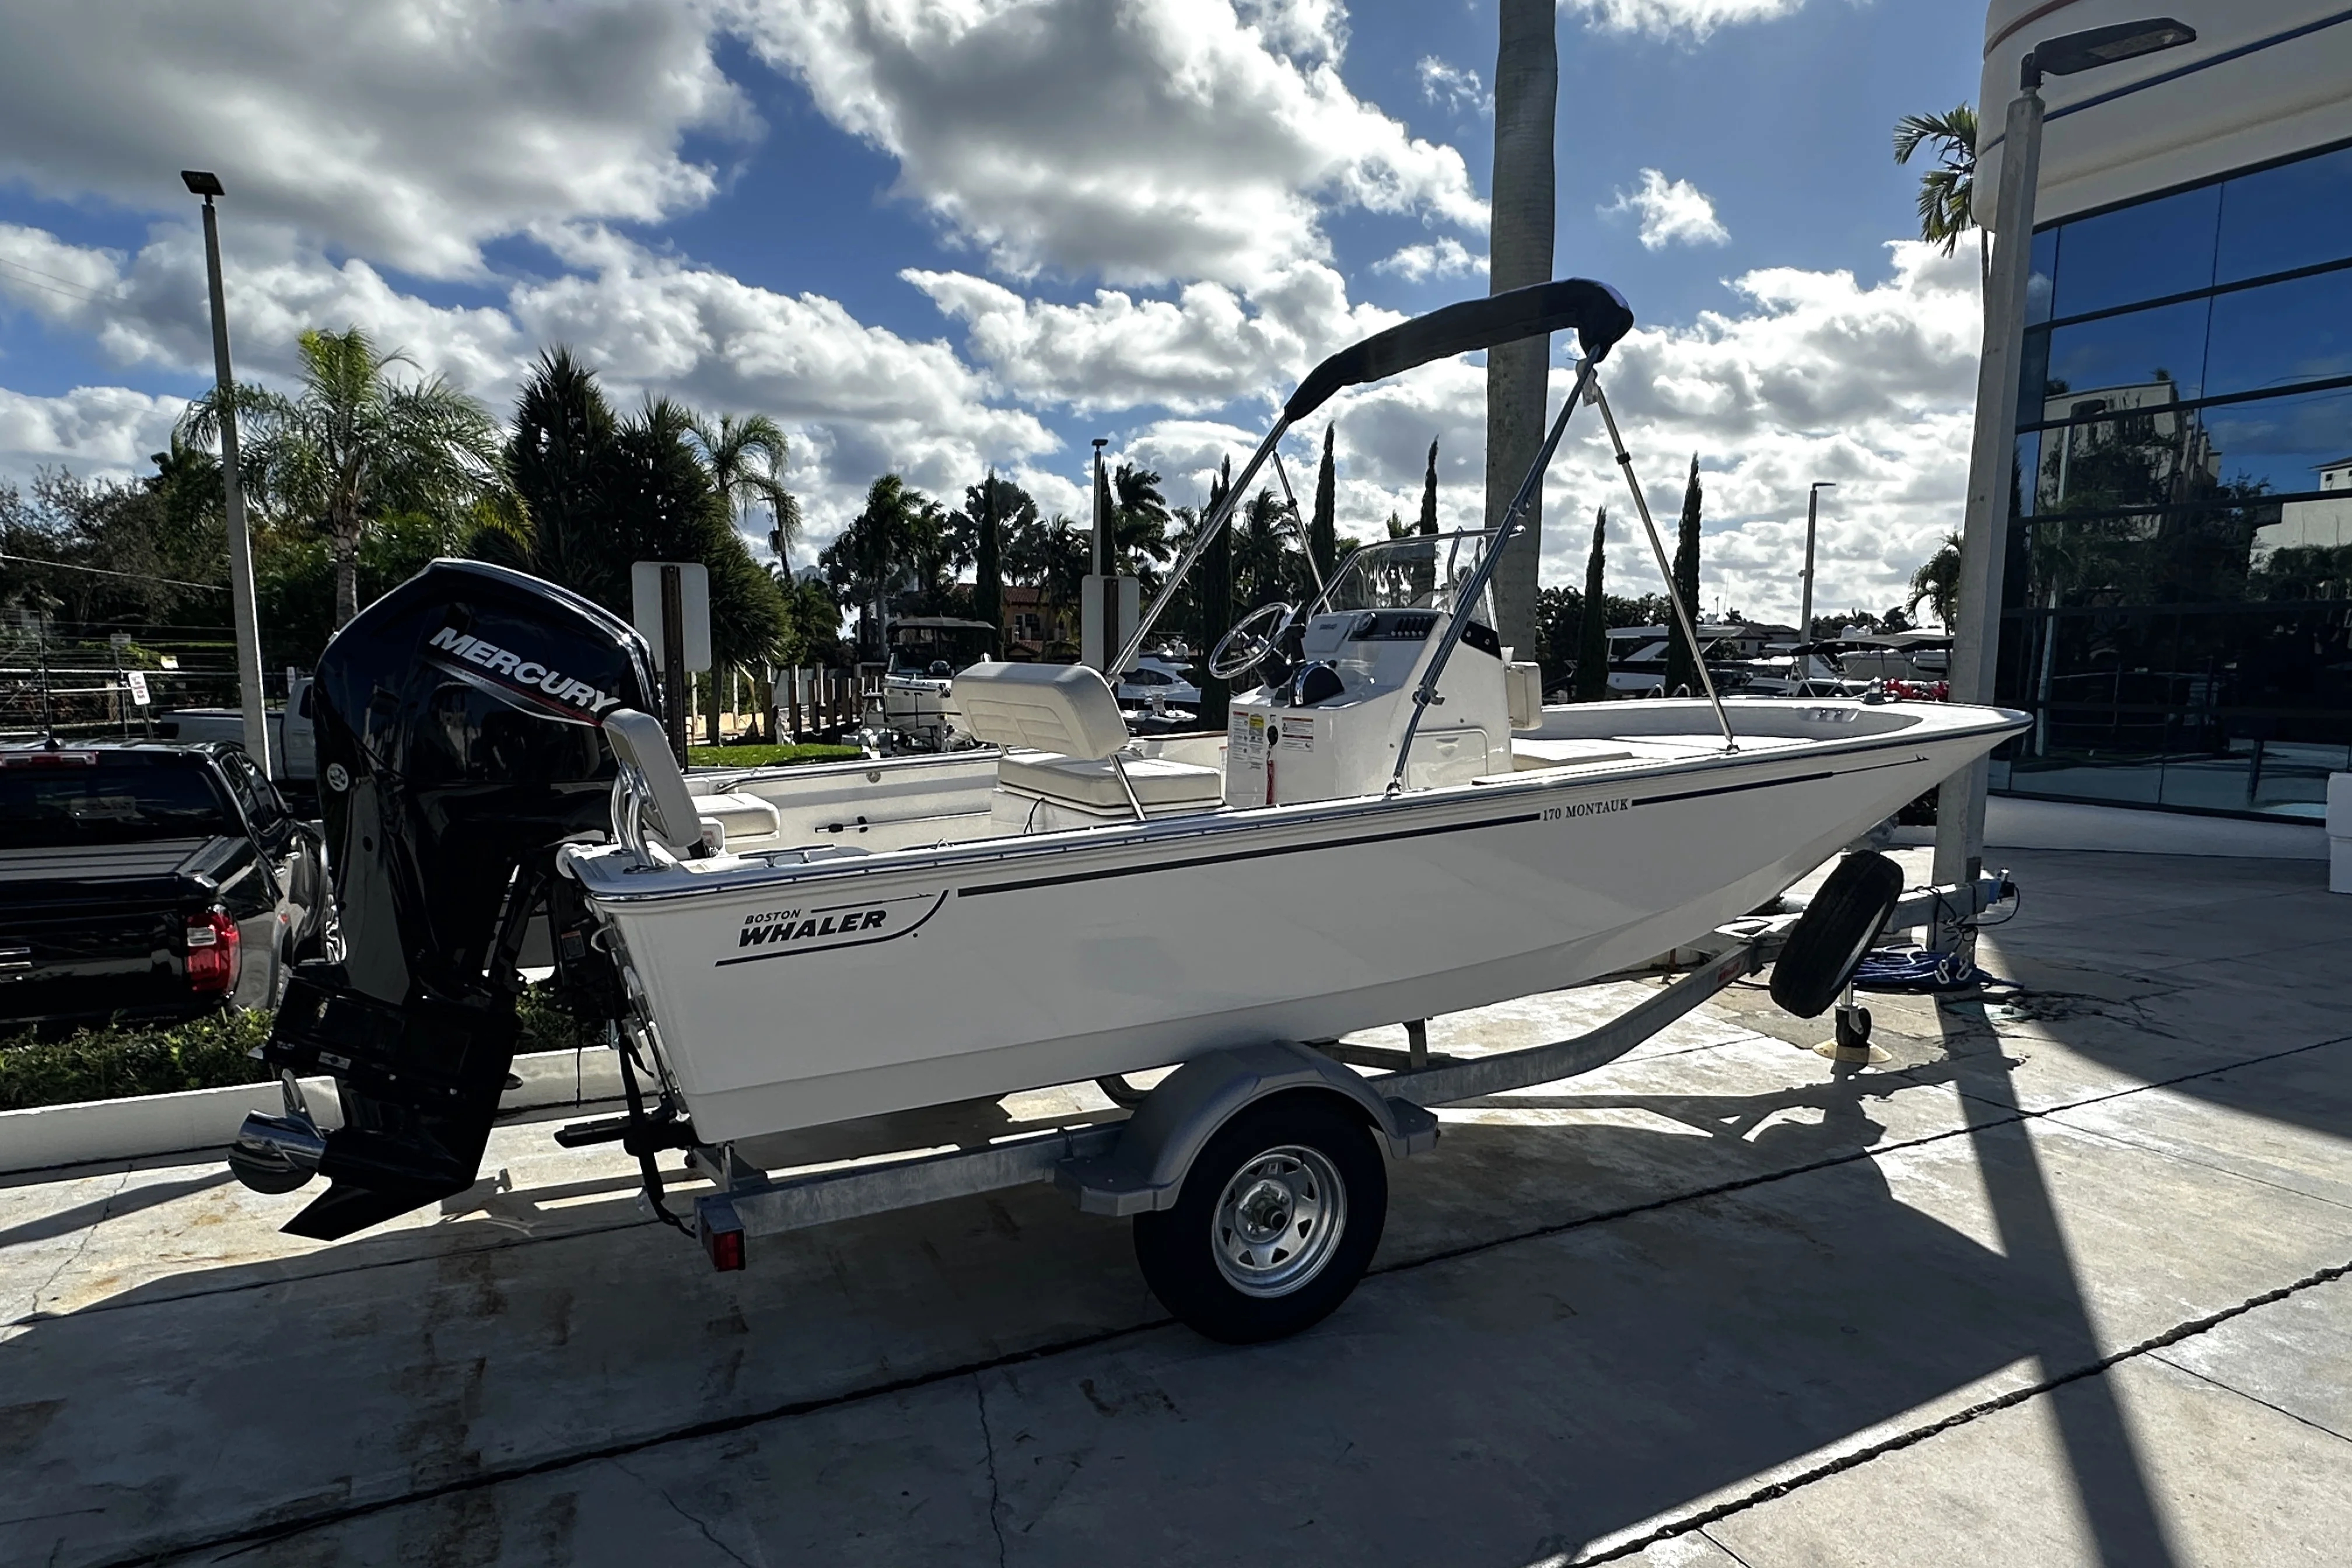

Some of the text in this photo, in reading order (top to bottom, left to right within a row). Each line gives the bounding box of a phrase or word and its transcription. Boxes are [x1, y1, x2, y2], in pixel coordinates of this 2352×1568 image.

[430, 627, 621, 712] MERCURY
[1542, 798, 1629, 821] 170 MONTAUK
[739, 910, 887, 947] WHALER
[745, 909, 801, 924] BOSTON
